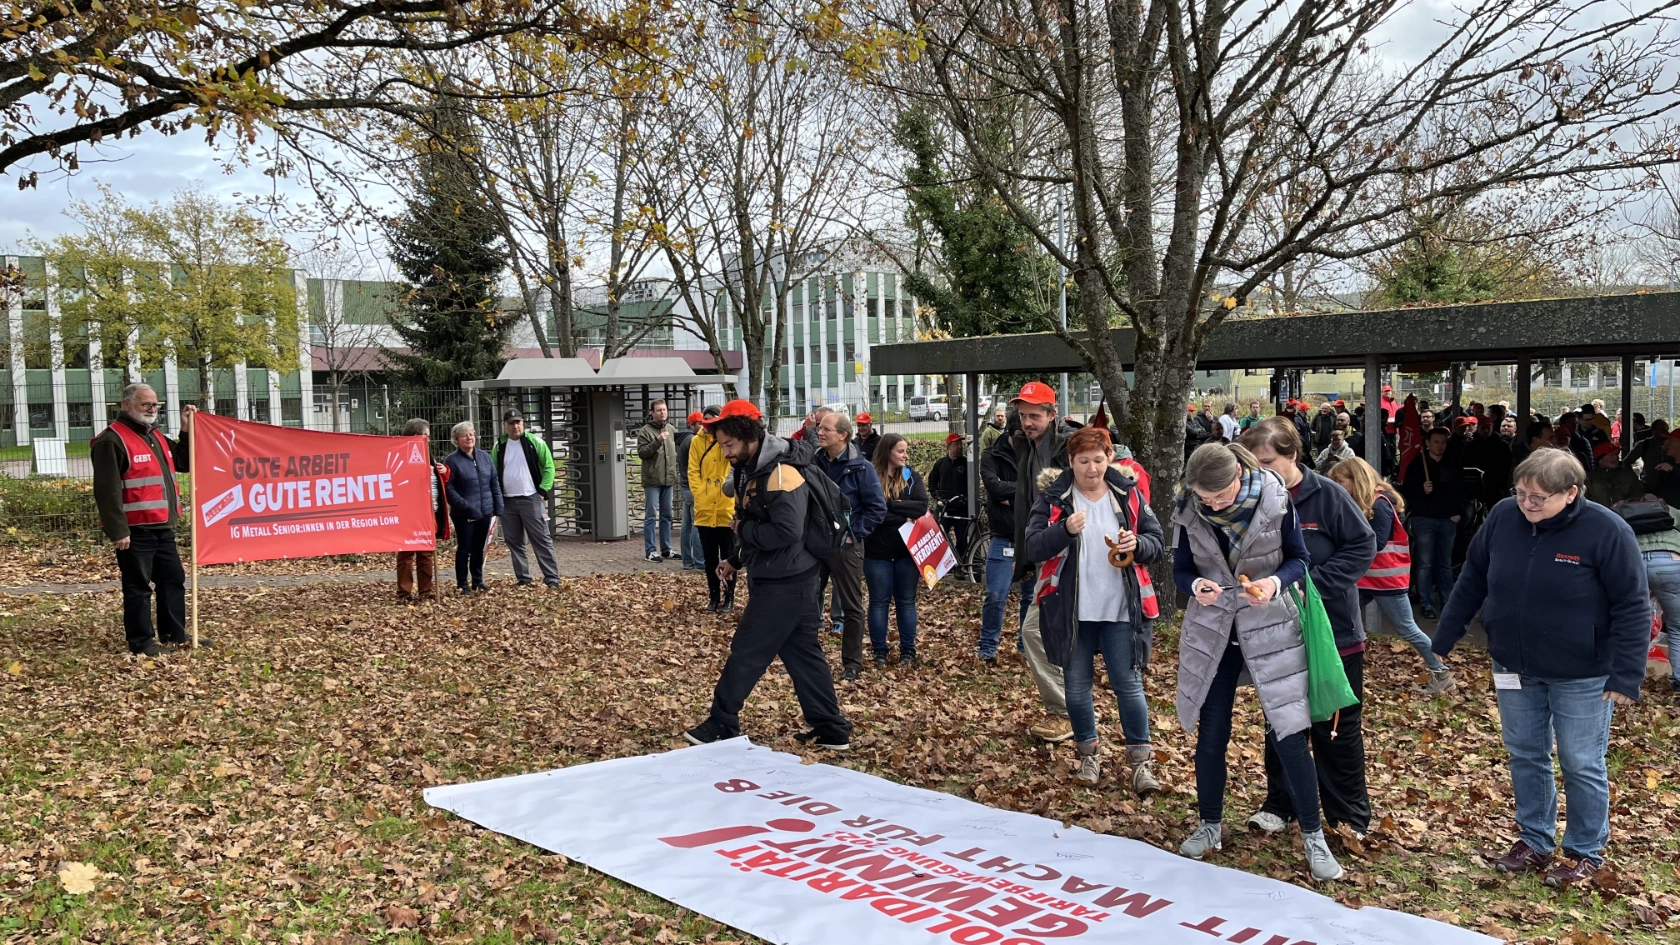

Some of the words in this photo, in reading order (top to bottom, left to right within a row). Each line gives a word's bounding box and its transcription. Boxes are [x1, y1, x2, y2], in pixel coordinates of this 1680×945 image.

[134, 454, 151, 463] GEBT
[232, 456, 281, 480] GUTE
[284, 453, 350, 478] ARBEIT
[249, 480, 311, 513] GUTE
[315, 473, 394, 507] RENTE
[230, 526, 240, 539] IG
[914, 530, 945, 566] VERDIENT!
[714, 778, 761, 793] 8
[756, 790, 843, 816] DIE
[841, 814, 946, 846] FÜR
[883, 846, 1110, 922] TARIFBEWEGUNG
[941, 846, 1174, 918] MACHT
